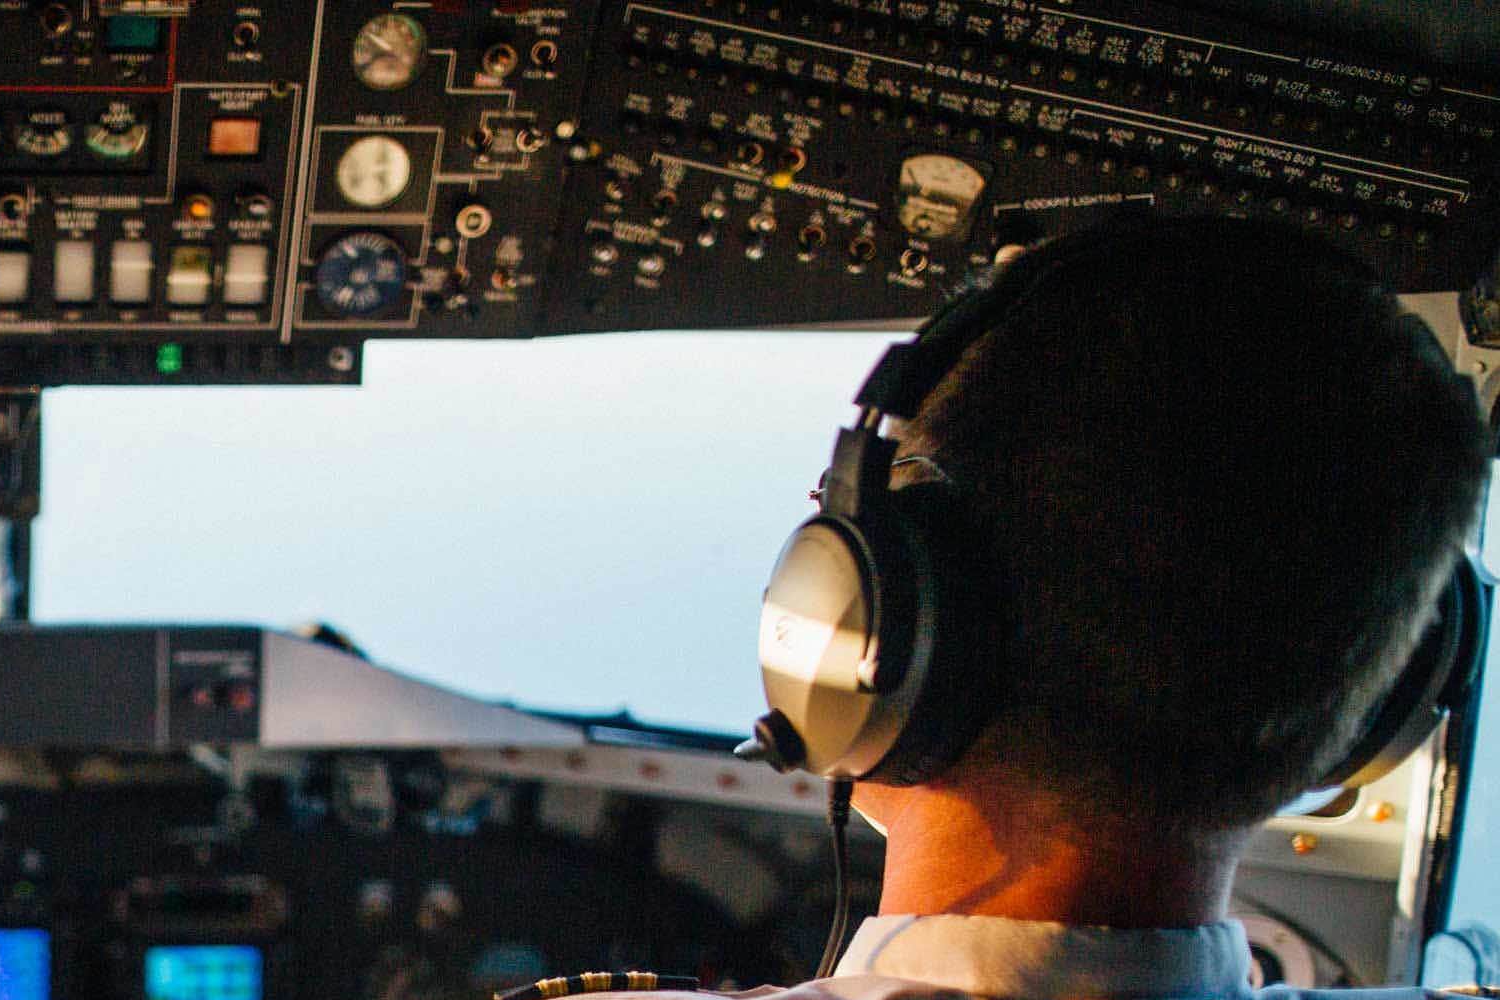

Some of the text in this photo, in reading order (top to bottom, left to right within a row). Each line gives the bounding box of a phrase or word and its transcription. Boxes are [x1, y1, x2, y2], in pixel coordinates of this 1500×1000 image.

[1305, 57, 1407, 86] LEFT AVIONICS BUS
[1213, 136, 1316, 167] RIGHT AVIONICS BUS
